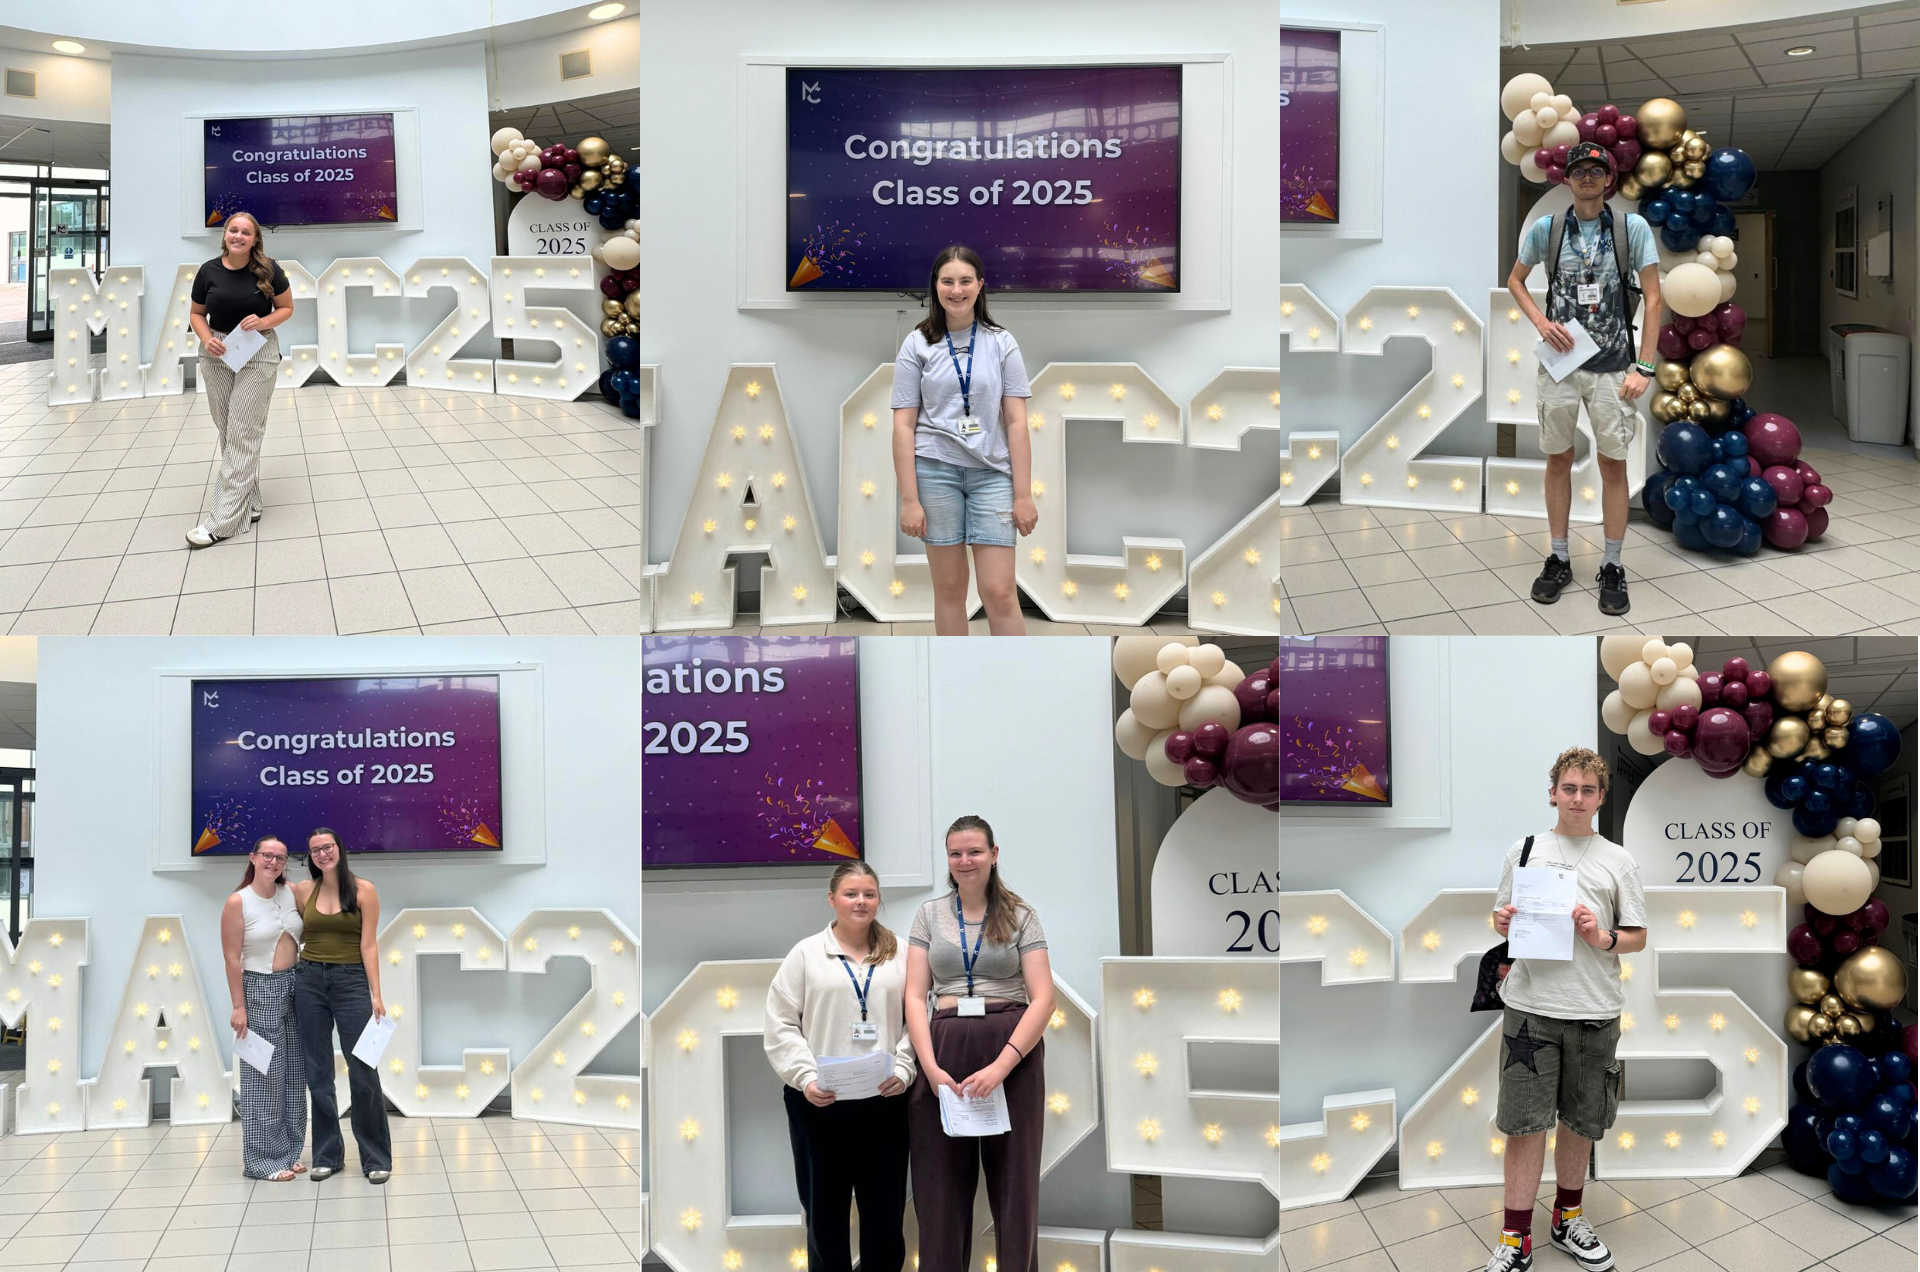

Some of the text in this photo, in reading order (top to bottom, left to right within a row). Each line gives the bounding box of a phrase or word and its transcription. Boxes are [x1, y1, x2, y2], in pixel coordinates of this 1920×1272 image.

[232, 145, 367, 164] Congratulations
[844, 132, 1122, 166] Congratulations
[246, 168, 354, 184] Class of 2025
[872, 178, 1093, 206] Class of 2025
[529, 221, 591, 233] CLASS OF
[536, 237, 586, 255] 2025
[640, 361, 1280, 634] ACC
[642, 658, 785, 694] ations
[237, 726, 456, 754] Congratulations
[643, 720, 750, 754] 2025
[260, 764, 434, 786] Class of 2025
[1664, 822, 1772, 840] CLASS OF
[1675, 851, 1762, 883] 2025
[0, 907, 640, 1136] MAC2
